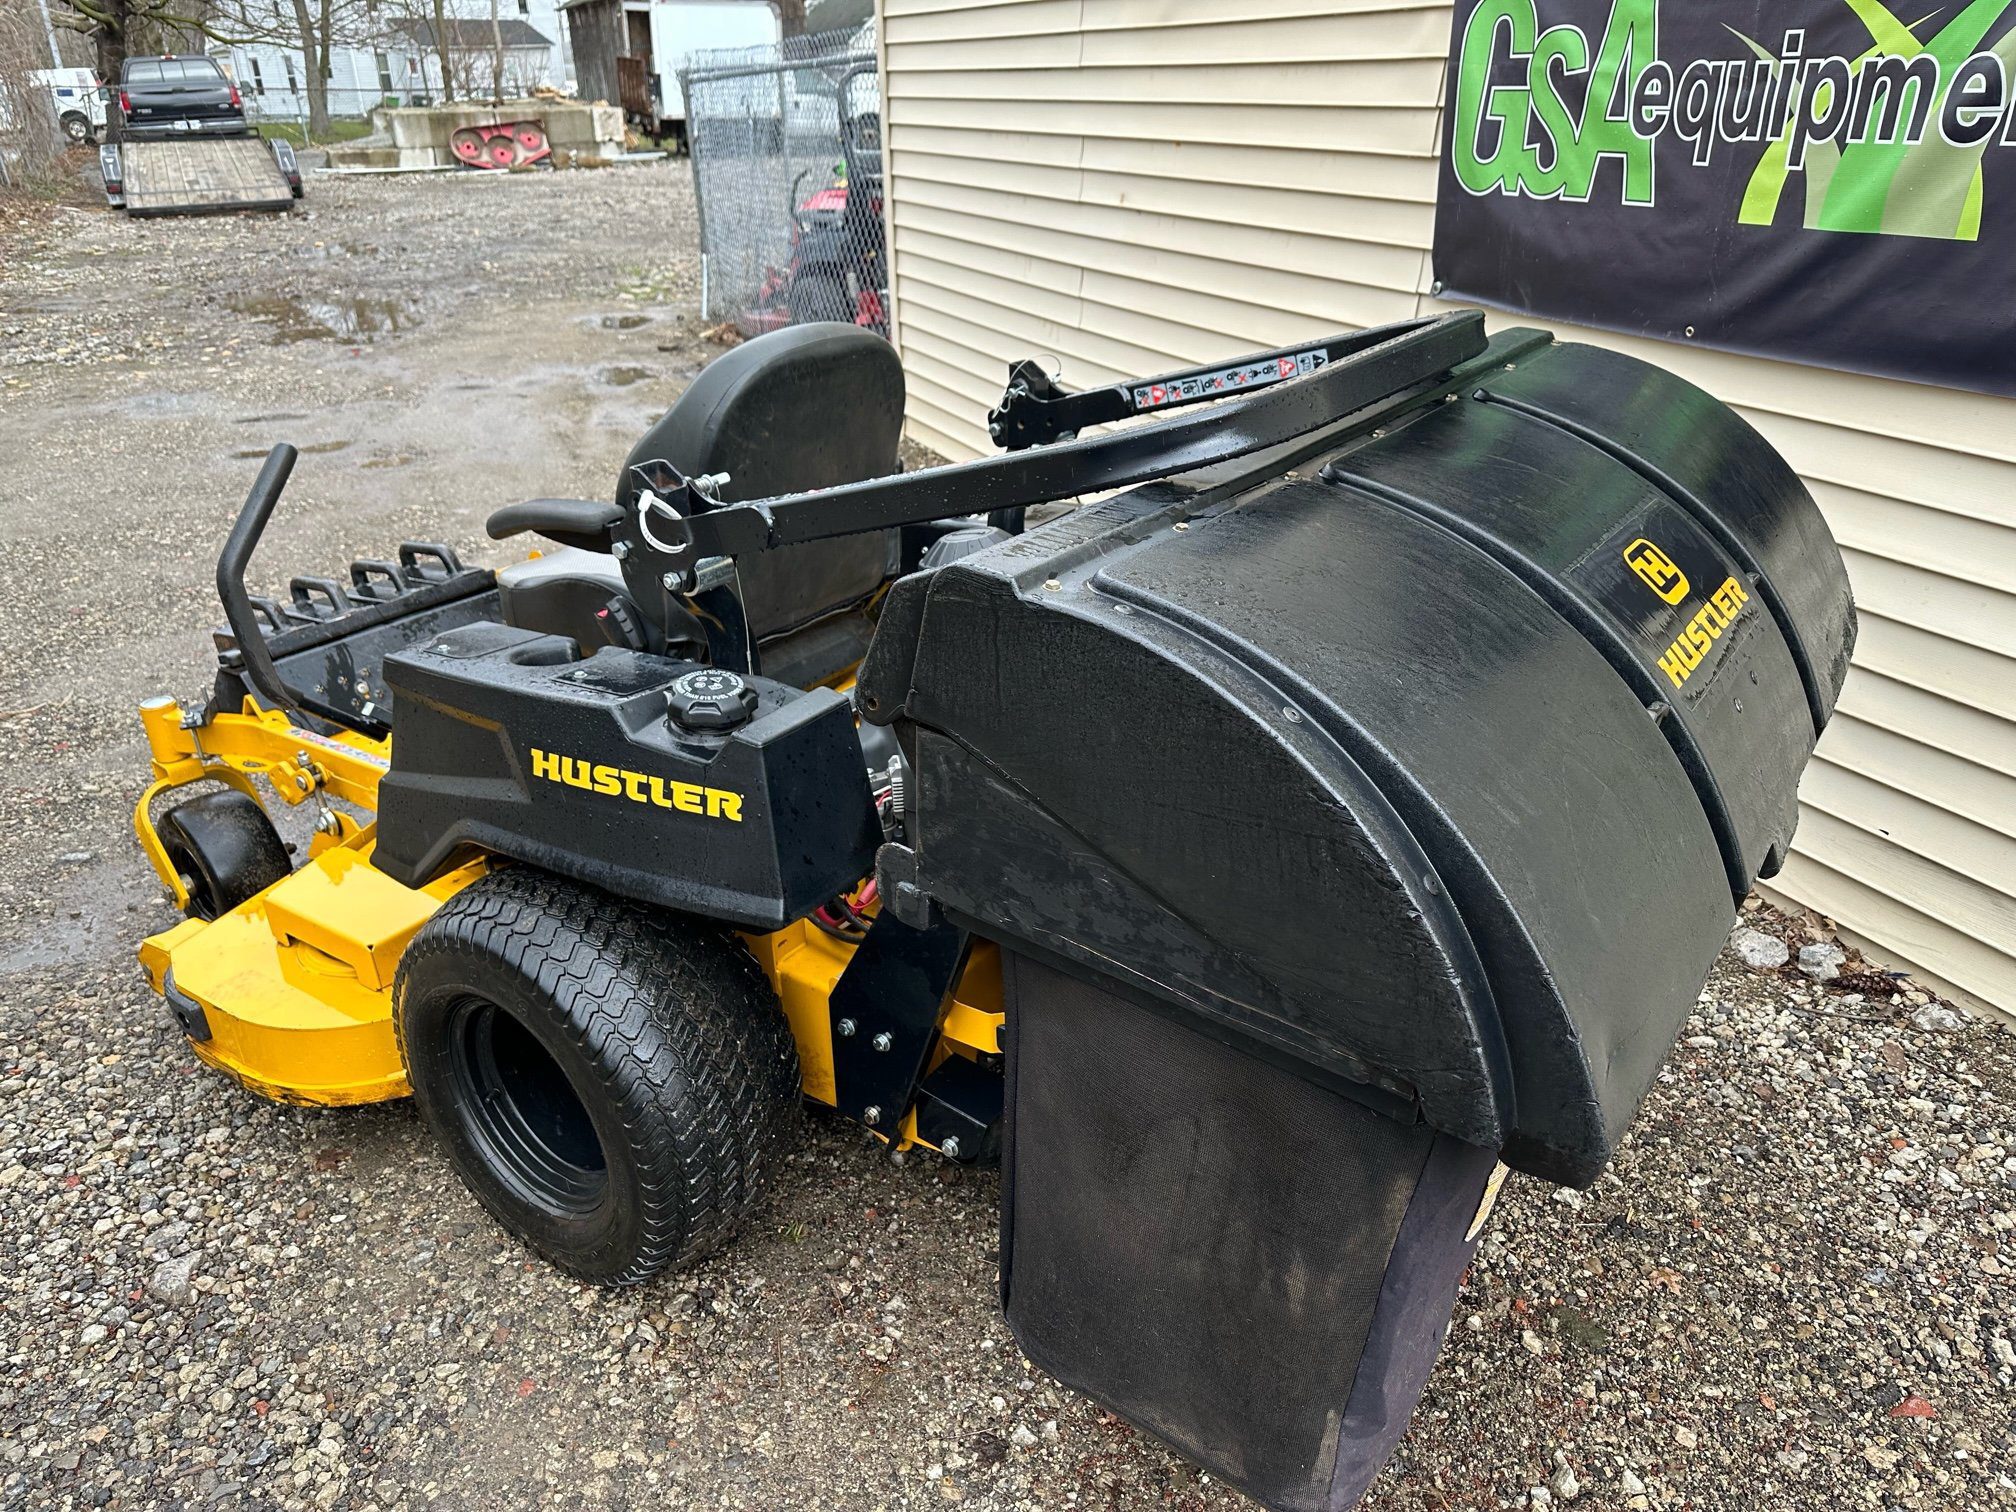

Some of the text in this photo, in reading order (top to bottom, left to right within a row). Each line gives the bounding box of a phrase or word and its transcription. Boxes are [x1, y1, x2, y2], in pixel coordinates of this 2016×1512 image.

[1630, 28, 2016, 171] equipme
[1657, 576, 1750, 690] HUSTLER
[531, 748, 743, 822] HUSTLER
